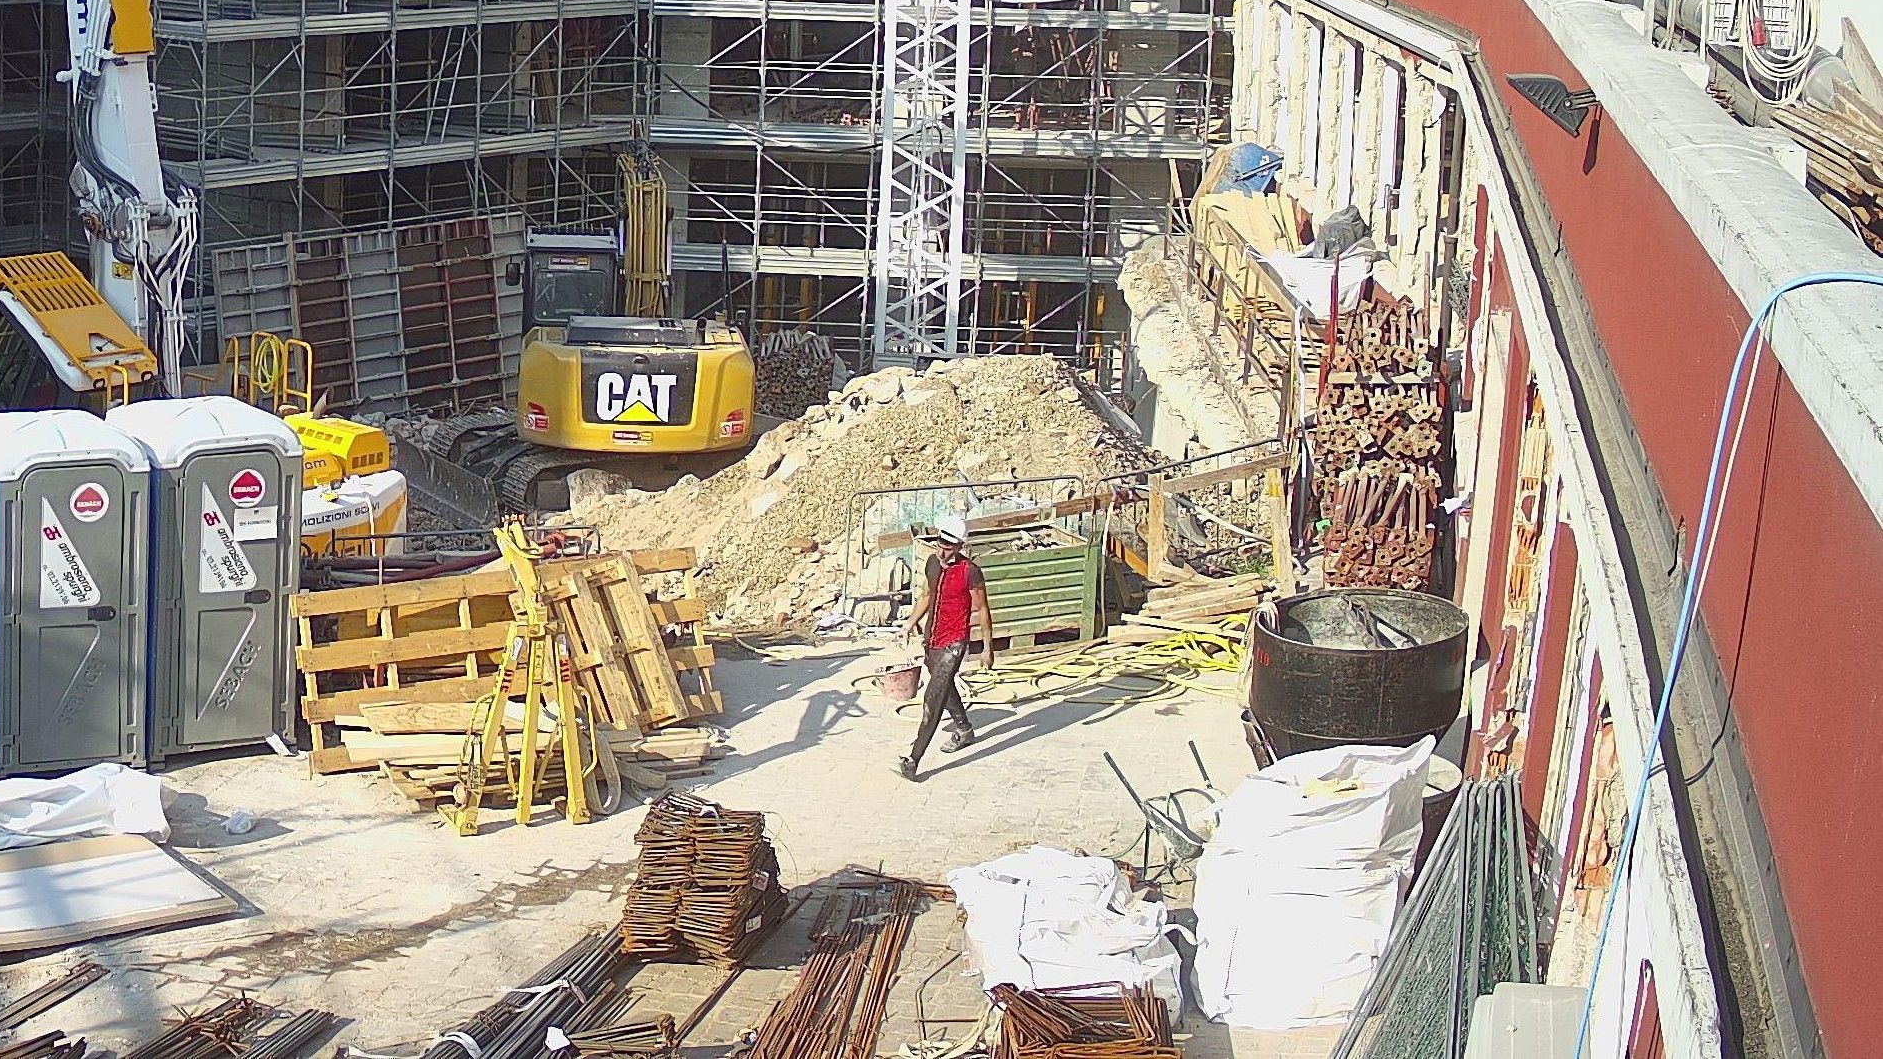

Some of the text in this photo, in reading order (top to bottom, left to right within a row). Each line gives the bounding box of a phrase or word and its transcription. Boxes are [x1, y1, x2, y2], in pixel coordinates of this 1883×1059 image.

[596, 372, 677, 423] CAT
[57, 542, 93, 593] ambrosiana
[62, 570, 91, 603] spurghi
